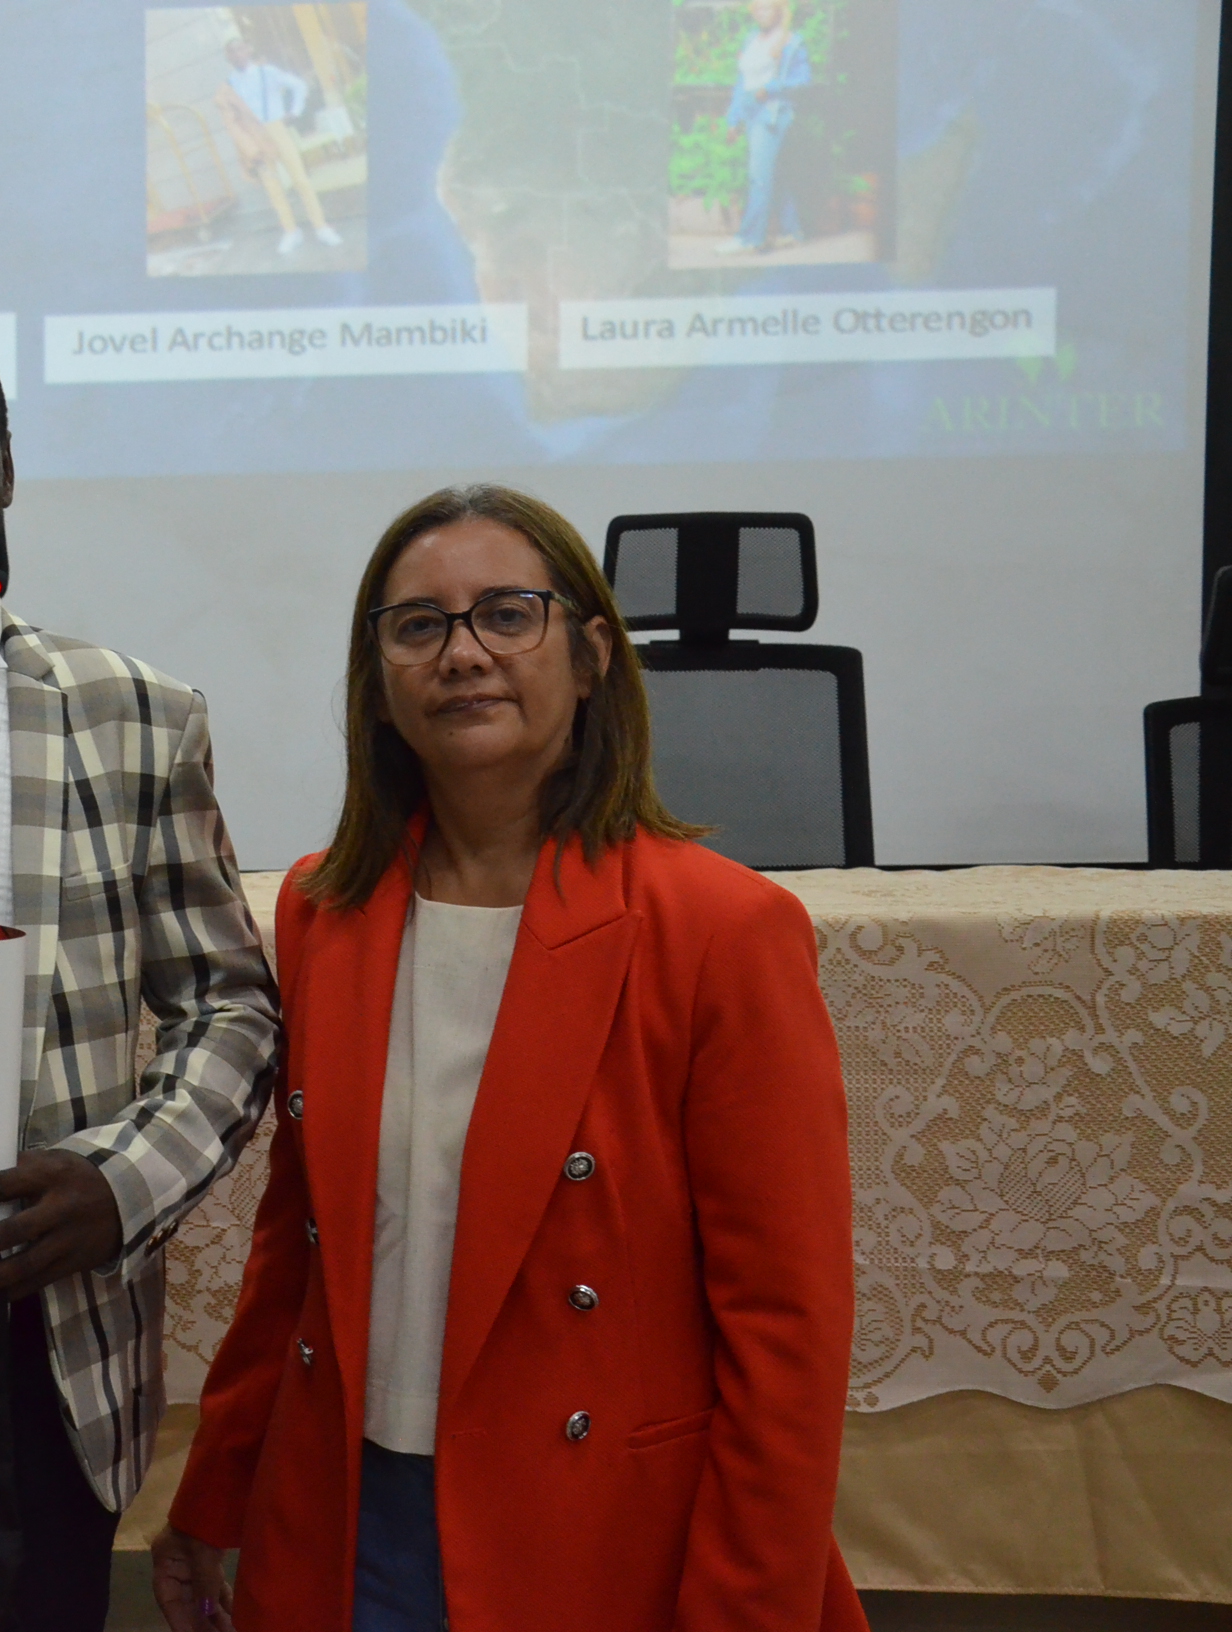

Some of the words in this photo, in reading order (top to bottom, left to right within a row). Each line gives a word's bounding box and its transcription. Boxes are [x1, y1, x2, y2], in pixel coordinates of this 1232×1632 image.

[72, 327, 158, 356] Jovel
[167, 324, 328, 356] Archange
[339, 317, 488, 348] Mambiki
[580, 314, 675, 342] Laura
[685, 309, 821, 338] Armelle
[832, 306, 1033, 337] Otterengon
